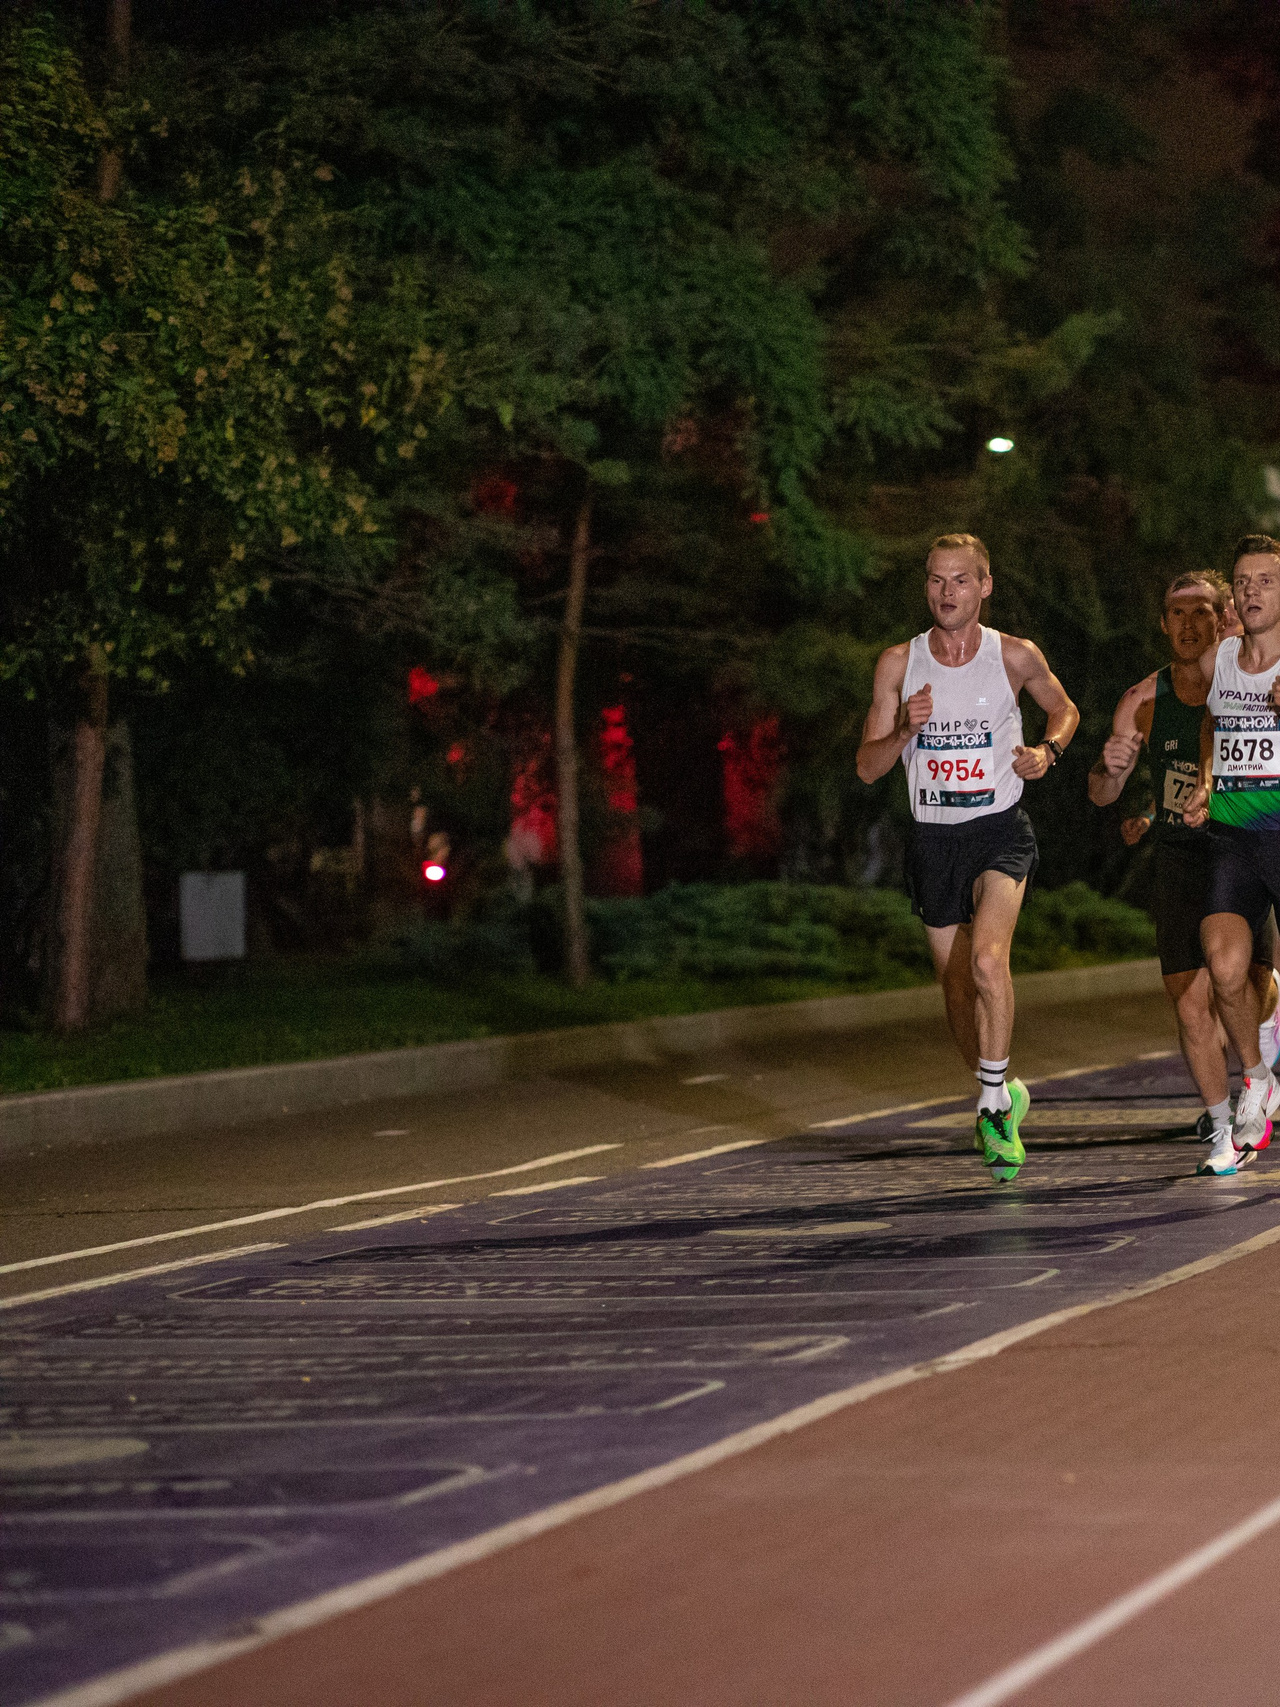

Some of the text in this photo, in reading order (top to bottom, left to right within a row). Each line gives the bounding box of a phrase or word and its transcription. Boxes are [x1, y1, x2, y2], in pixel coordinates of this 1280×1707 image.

[924, 733, 986, 747] НОЧНОЙ
[1220, 738, 1274, 761] 5678
[927, 759, 985, 781] 9954
[1227, 763, 1264, 772] ДМИТРИЙ
